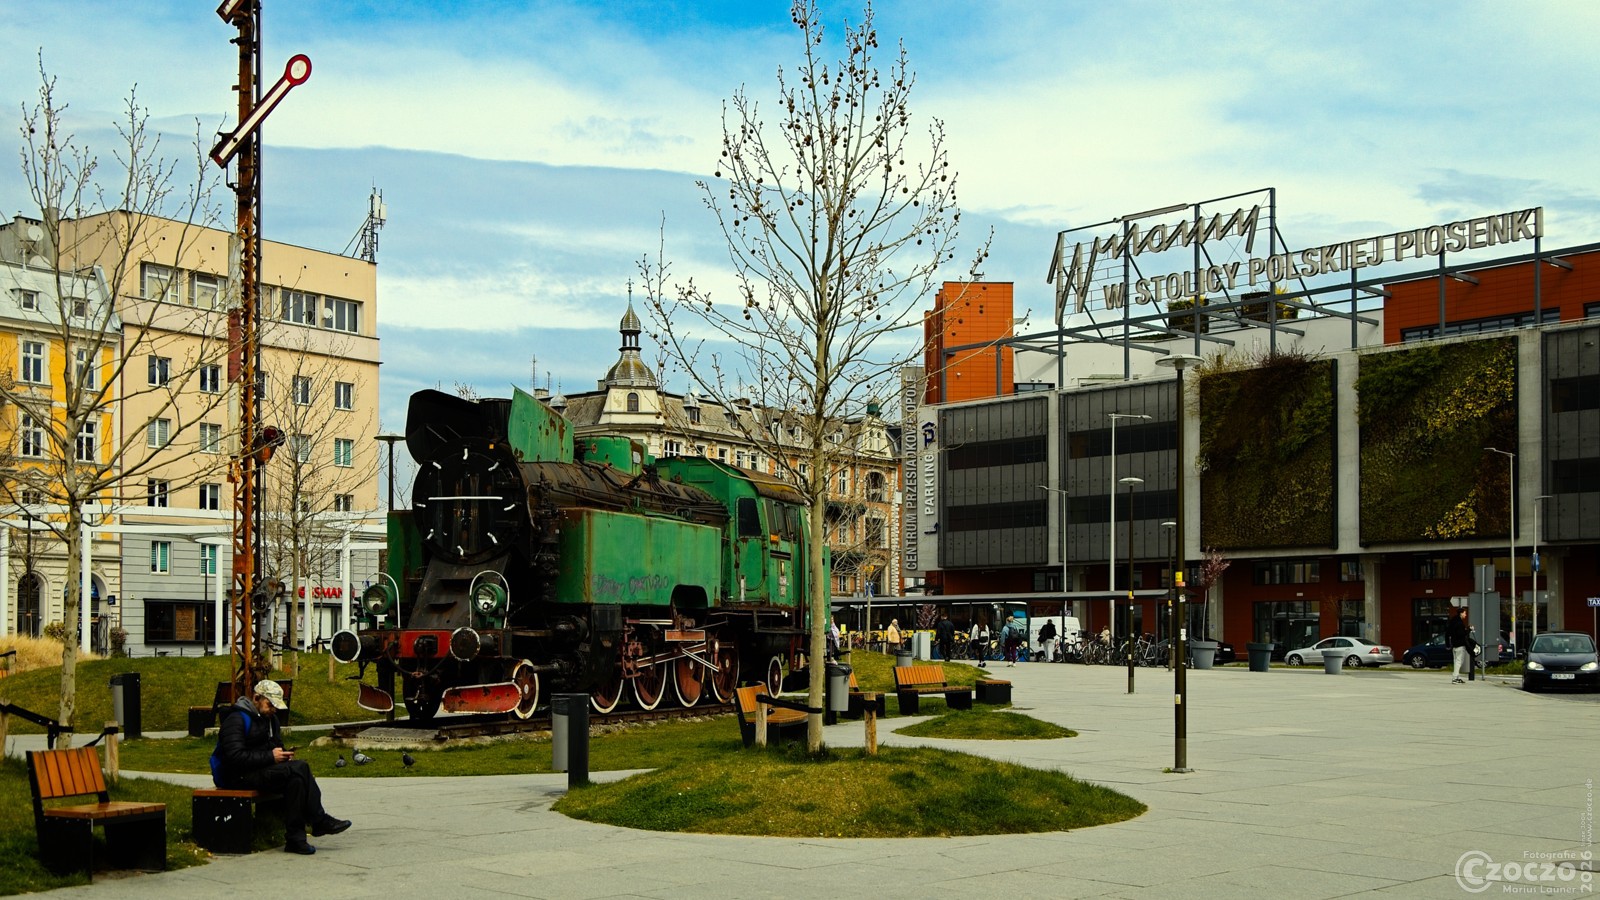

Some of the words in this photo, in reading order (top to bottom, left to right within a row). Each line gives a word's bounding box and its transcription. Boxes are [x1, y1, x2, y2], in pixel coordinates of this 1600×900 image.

[1103, 282, 1126, 310] W
[1134, 261, 1241, 305] STOLICY
[1248, 235, 1384, 286] POLSKIEJ
[1394, 206, 1544, 262] PIOSENKI
[905, 375, 917, 411] OPOLE
[924, 454, 935, 515] PARKING
[905, 513, 917, 570] CENTRUM
